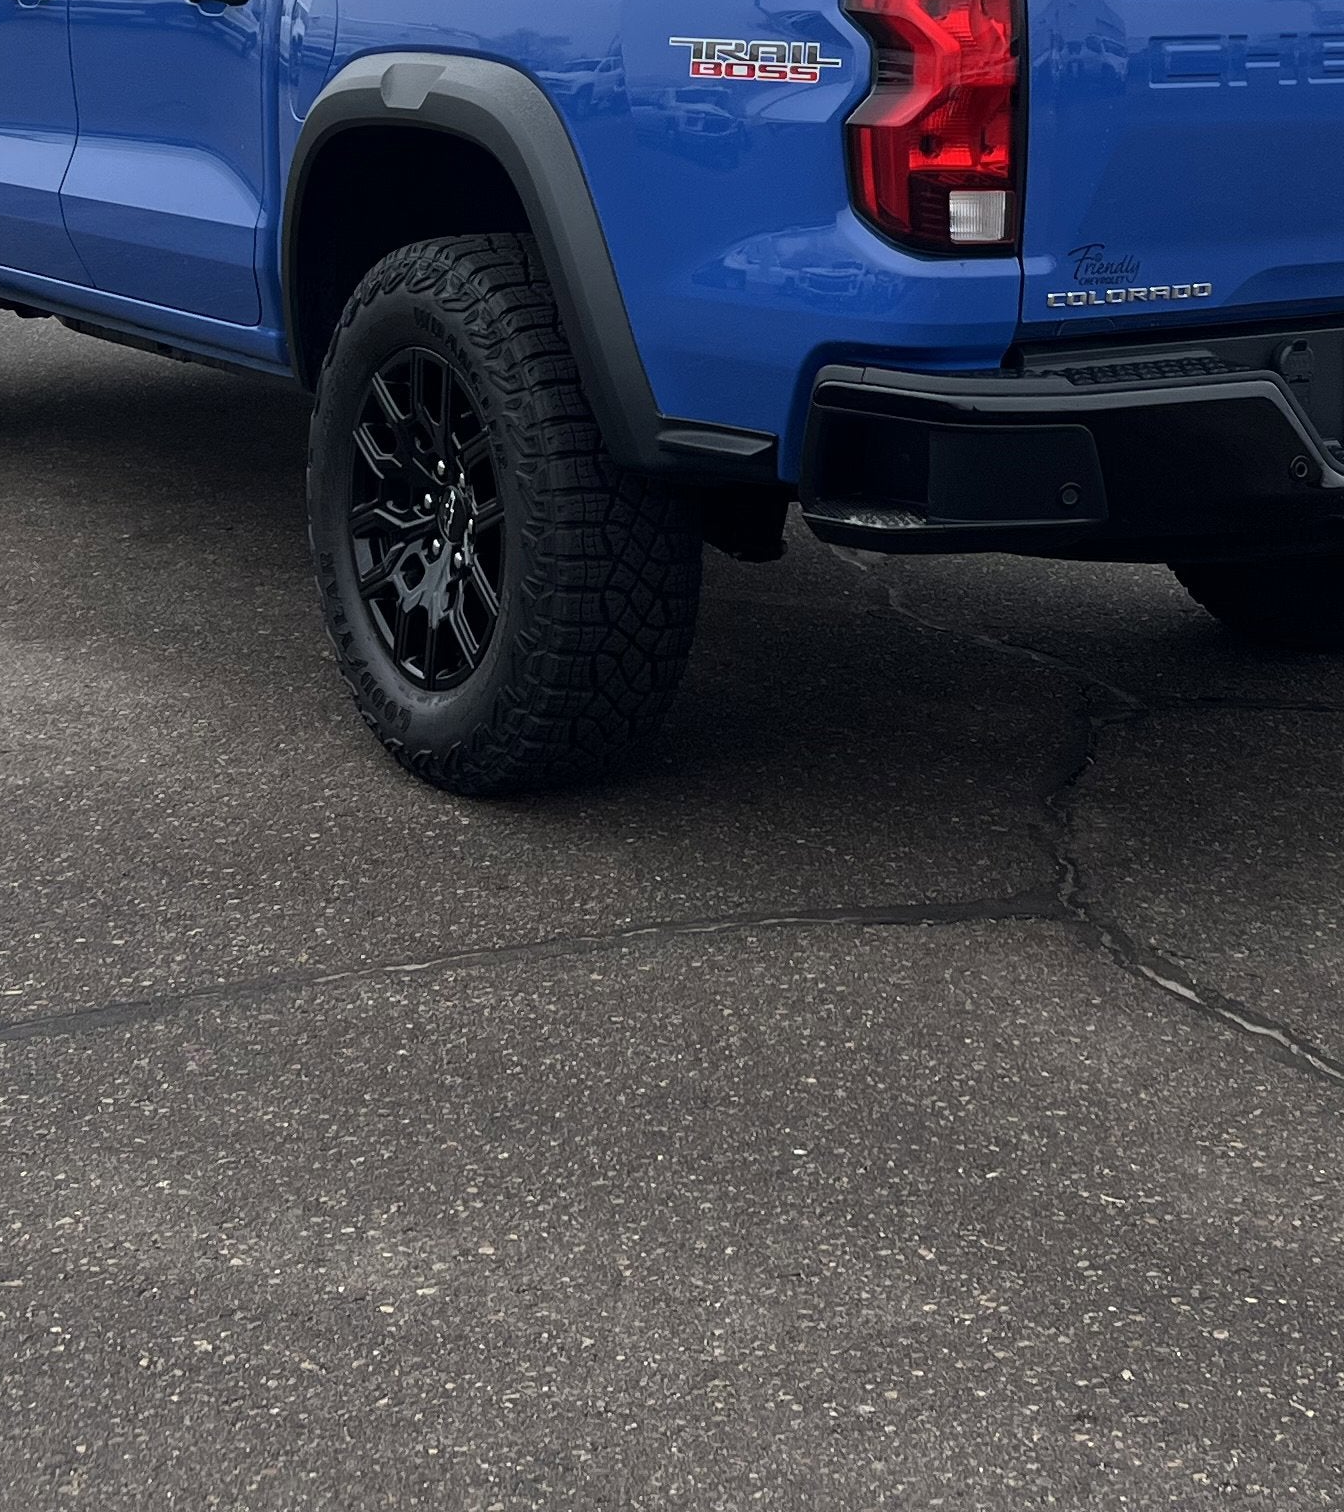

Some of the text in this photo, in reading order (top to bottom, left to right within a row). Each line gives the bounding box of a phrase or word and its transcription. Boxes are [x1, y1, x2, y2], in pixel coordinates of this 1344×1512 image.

[669, 37, 842, 68] TRAIL
[689, 60, 820, 83] BOSS
[1068, 243, 1140, 284] Friendly
[1047, 282, 1213, 308] COLORADO
